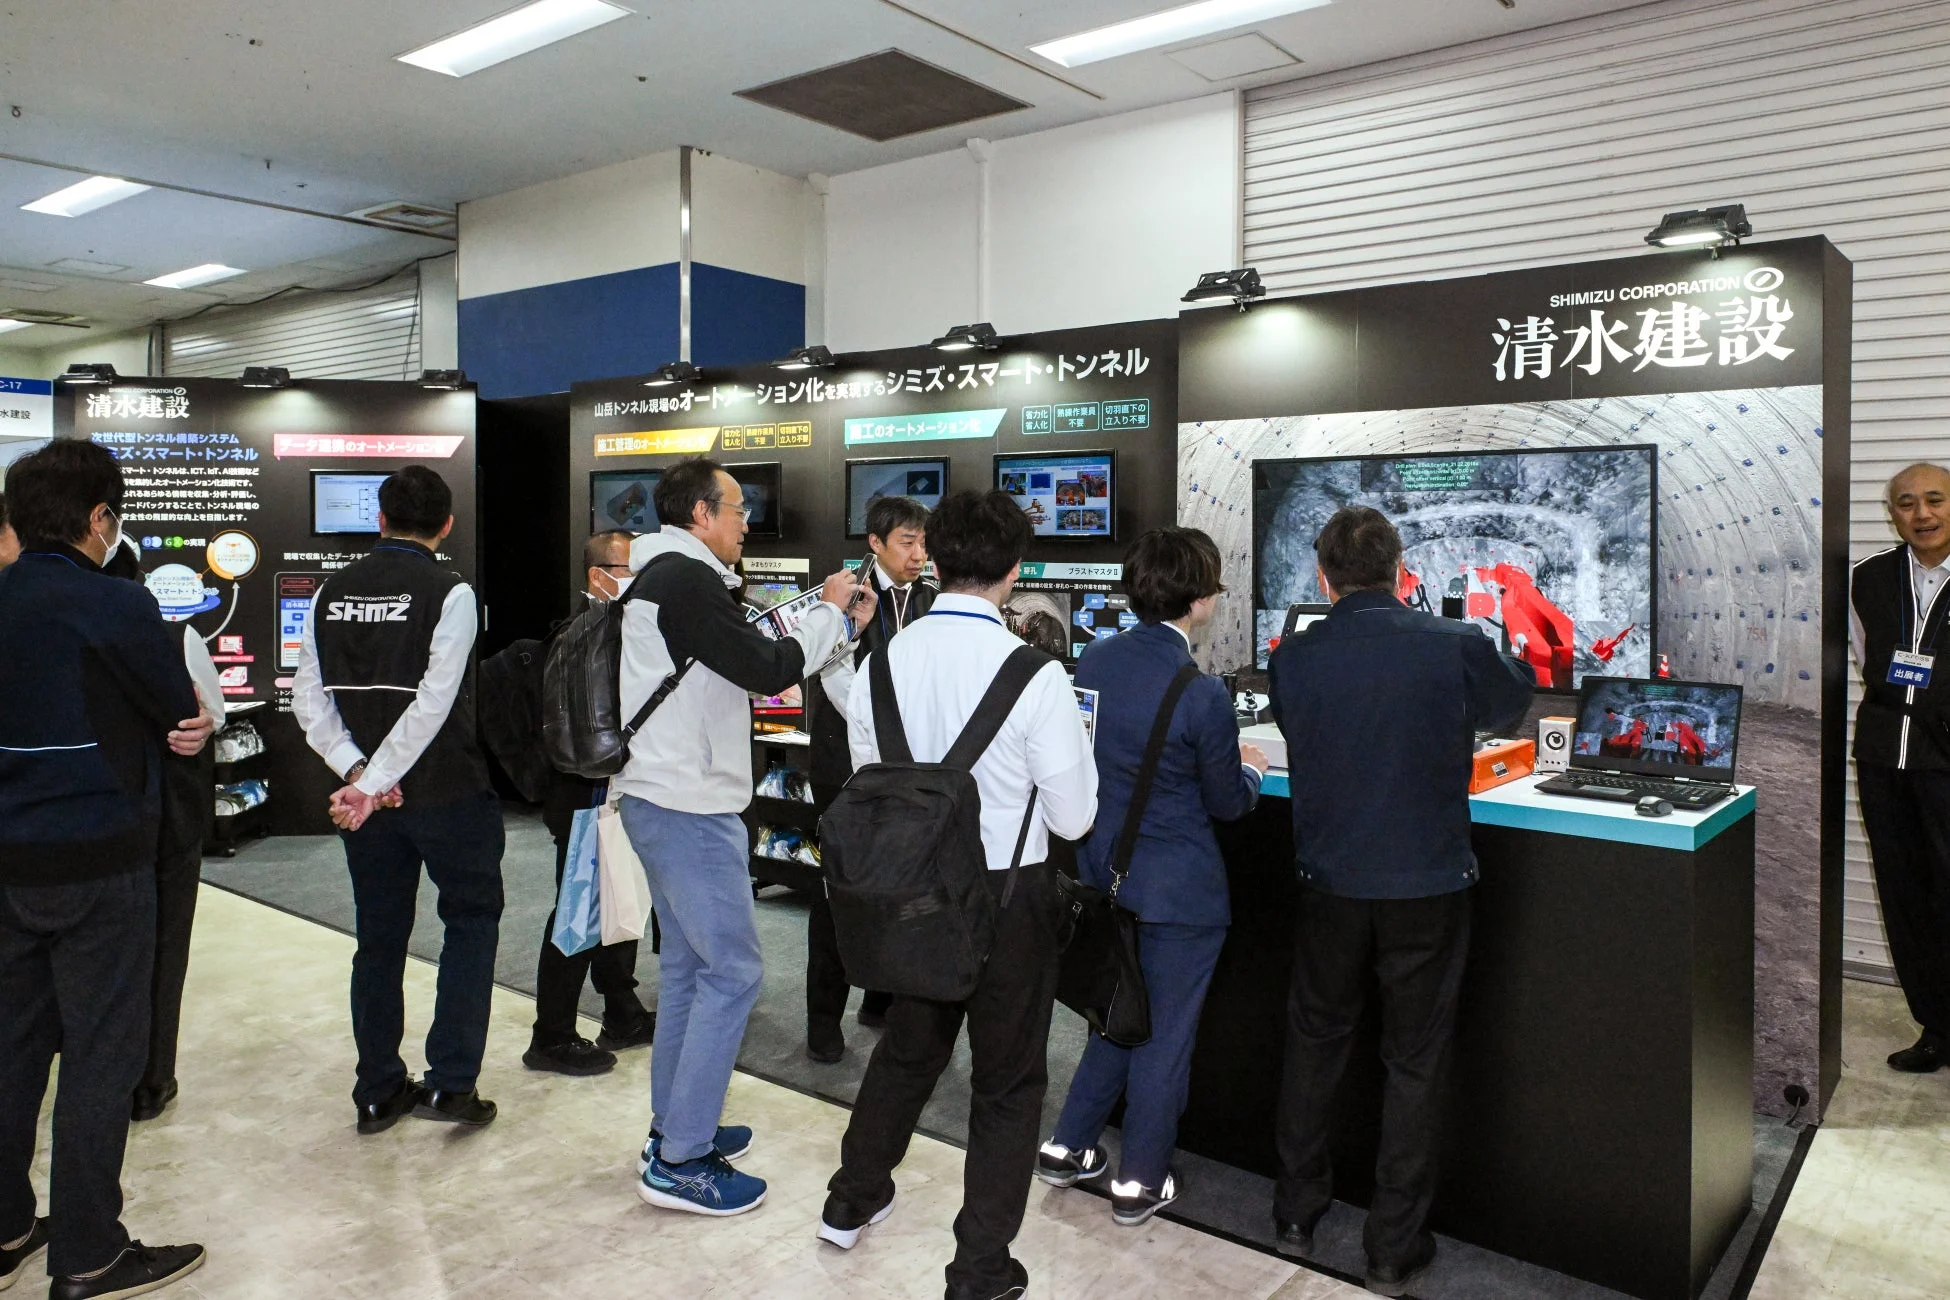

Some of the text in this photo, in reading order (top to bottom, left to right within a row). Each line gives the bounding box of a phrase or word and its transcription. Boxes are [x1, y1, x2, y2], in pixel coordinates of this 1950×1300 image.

[1549, 275, 1740, 308] SHIMIZU CORPORATION
[1491, 293, 1796, 382] 清水建設
[86, 393, 190, 419] 清水建設
[1068, 416, 1084, 428] 不要
[91, 432, 240, 444] 次世代型トンネル構築システム
[1894, 668, 1924, 682] 出展者
